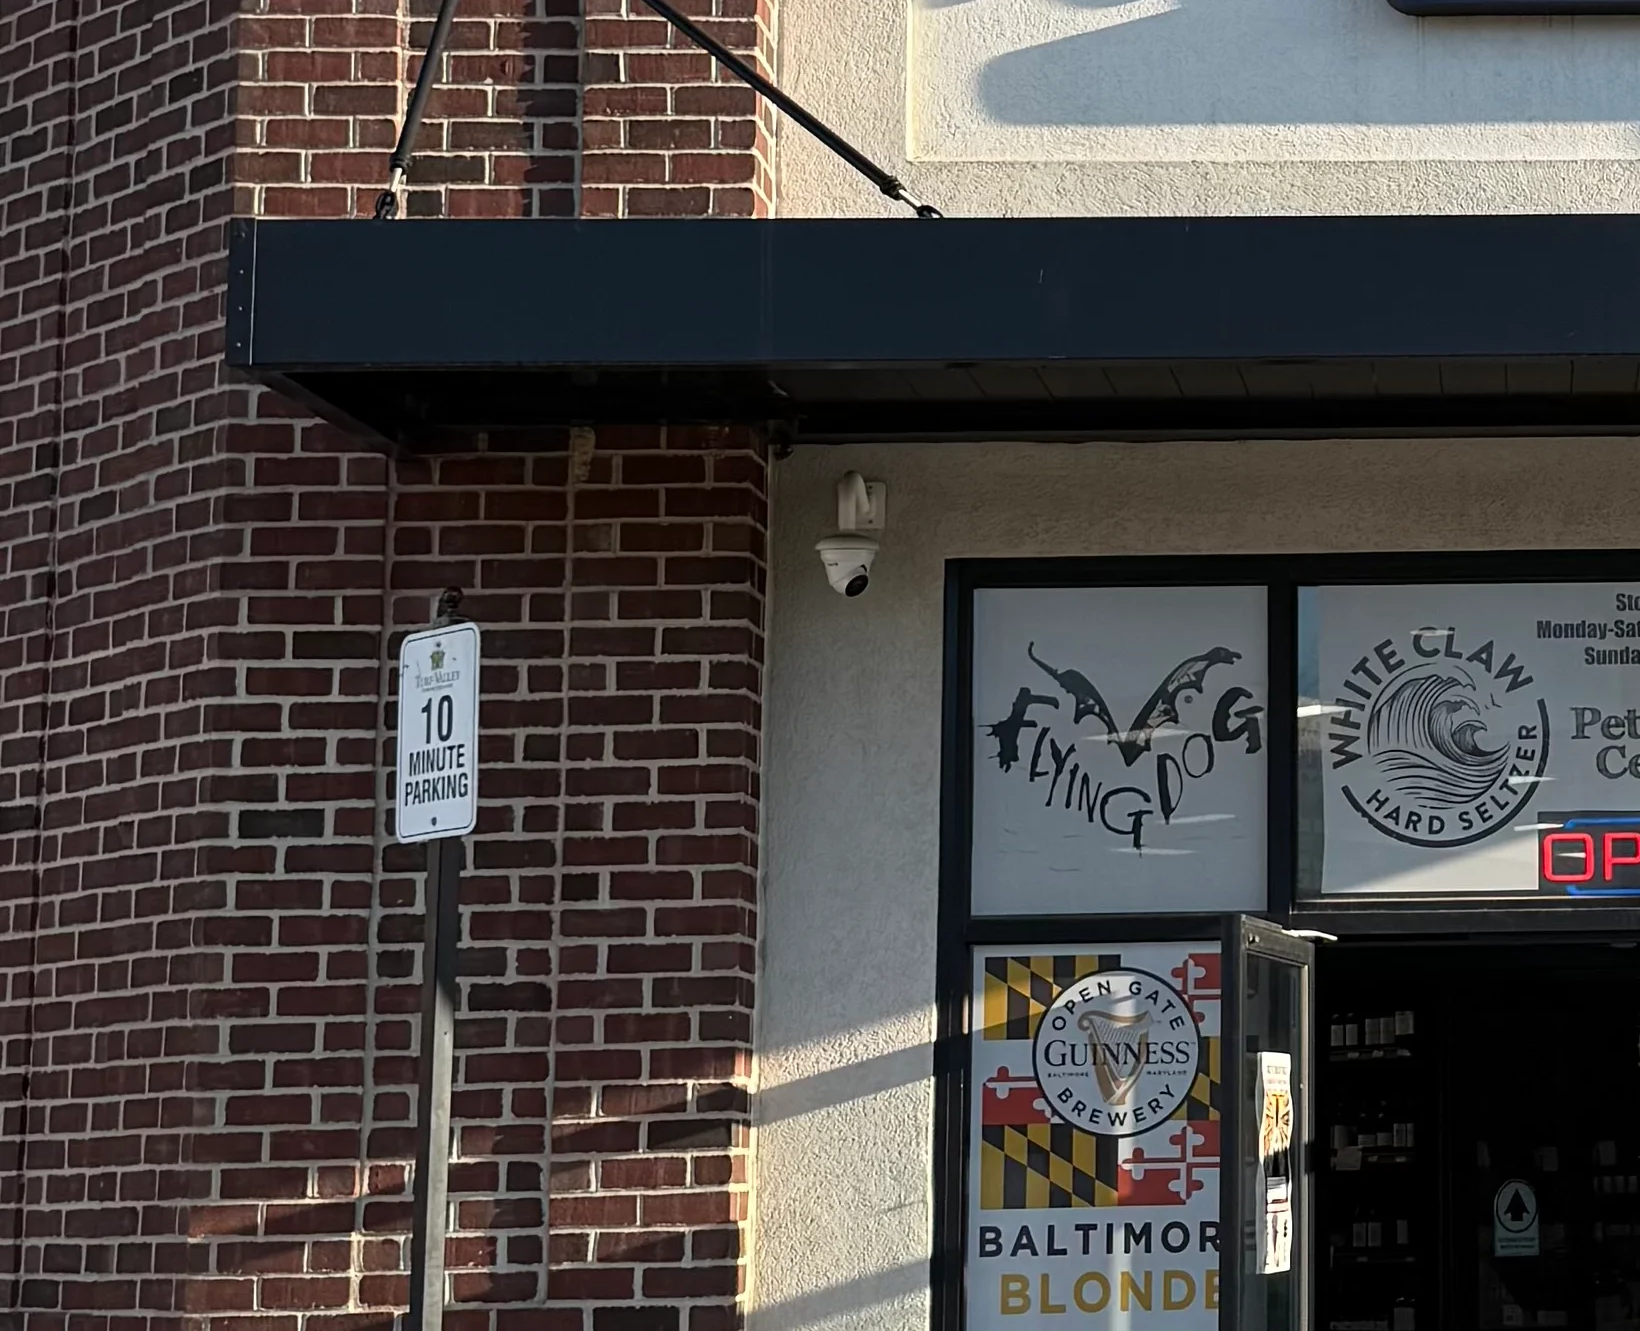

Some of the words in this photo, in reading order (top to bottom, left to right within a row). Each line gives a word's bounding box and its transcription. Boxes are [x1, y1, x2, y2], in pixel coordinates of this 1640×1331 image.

[420, 694, 454, 745] 10
[1328, 638, 1406, 769] WHITE
[1412, 626, 1534, 693] CLAW
[409, 743, 466, 777] MINUTE
[977, 686, 1154, 858] FLYING
[1156, 686, 1266, 824] DOG
[1365, 788, 1445, 835] HARD
[1458, 724, 1538, 831] SELTZER
[404, 772, 469, 807] PARKING
[1051, 980, 1113, 1031] OPEN
[1128, 980, 1185, 1031] GATE
[1043, 1039, 1191, 1067] GUINNESS
[1056, 1084, 1176, 1127] BREWERY
[979, 1220, 1220, 1259] BALTIMOR
